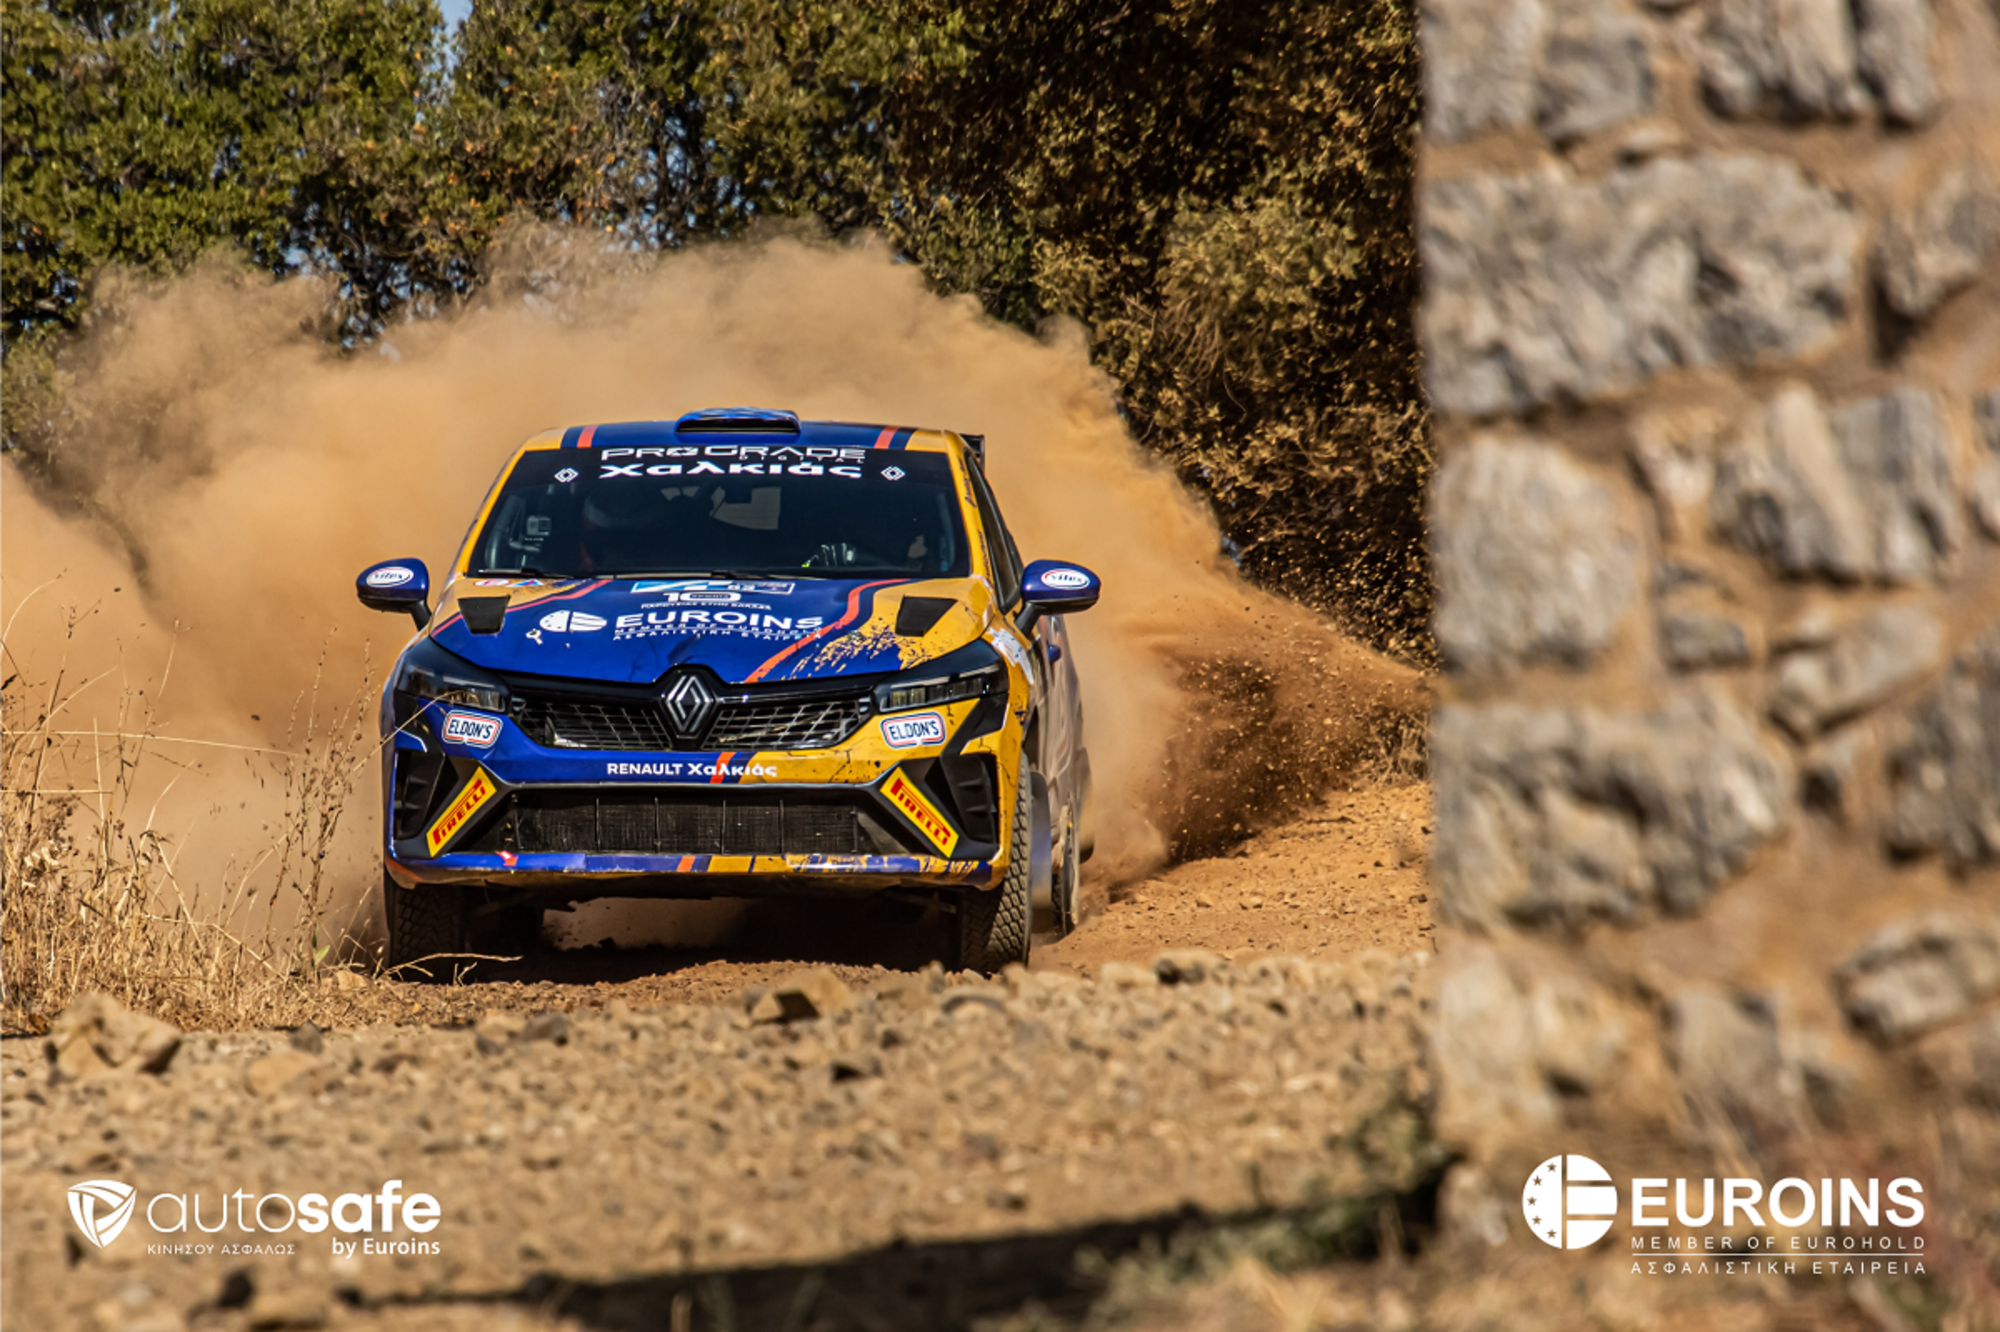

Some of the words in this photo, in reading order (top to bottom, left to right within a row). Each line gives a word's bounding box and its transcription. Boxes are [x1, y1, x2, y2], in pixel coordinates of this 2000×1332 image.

[616, 610, 823, 630] EUROINS
[448, 719, 494, 739] ELDON'S
[888, 720, 940, 740] ELDON'S
[607, 763, 683, 775] RENAULT
[687, 763, 777, 777] Χαλκιάς
[432, 779, 486, 846] PIRELLI
[890, 778, 951, 846] PIRELLI
